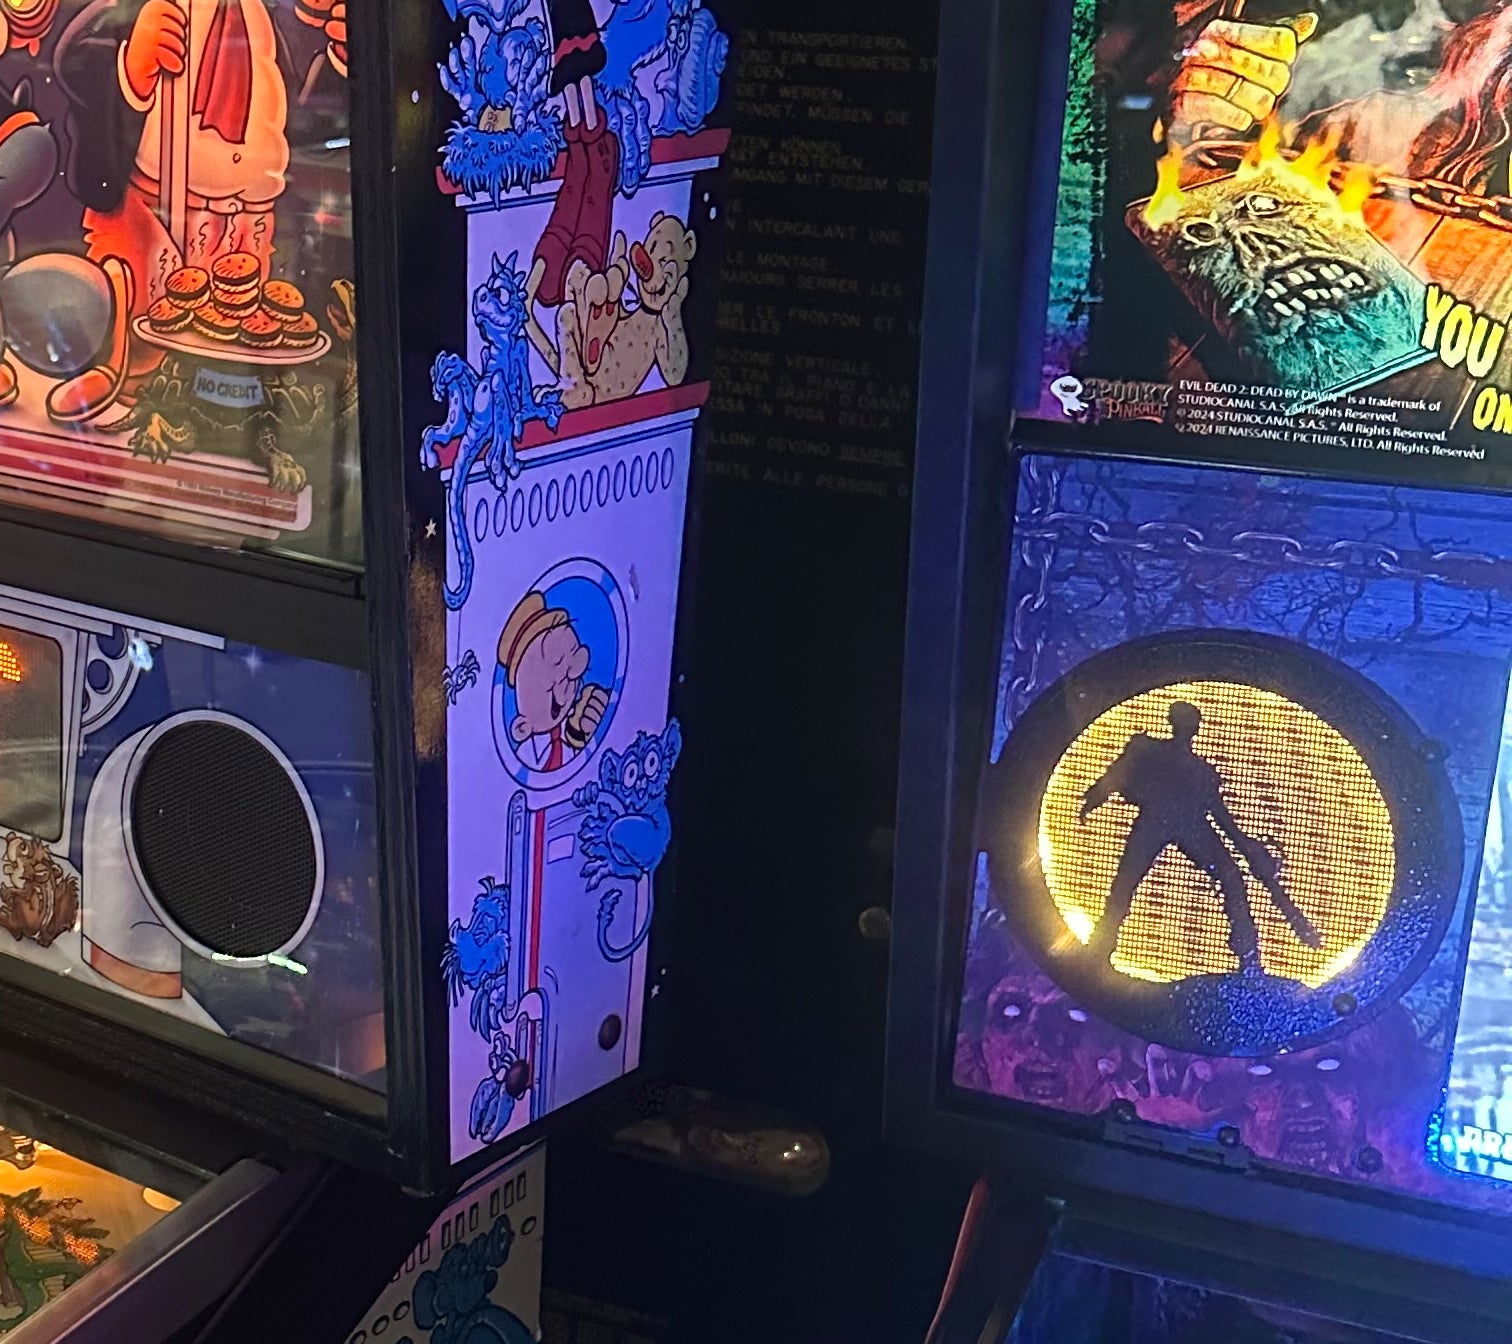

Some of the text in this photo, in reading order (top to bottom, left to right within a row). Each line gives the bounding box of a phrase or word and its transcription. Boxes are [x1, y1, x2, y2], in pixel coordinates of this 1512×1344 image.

[1421, 283, 1505, 378] YOU
[197, 377, 258, 399] NO CREDIT
[1083, 377, 1173, 406] SPOOKY
[1180, 379, 1202, 391] EVIL
[1204, 382, 1237, 394] DEAD
[1251, 386, 1282, 398] DEAD
[1284, 389, 1299, 399] BY
[1348, 395, 1356, 404] is
[1359, 397, 1366, 405] a
[1368, 396, 1425, 410] trademark
[1428, 401, 1441, 411] of
[1178, 394, 1256, 409] STUDIOCANAL
[1310, 405, 1342, 419] Rights
[1188, 410, 1214, 420] 2024
[1216, 412, 1296, 428] STUDIOCANAL
[1356, 424, 1391, 437] Rights
[1215, 427, 1291, 442] RENAISSANCE
[1394, 441, 1429, 456] Rights
